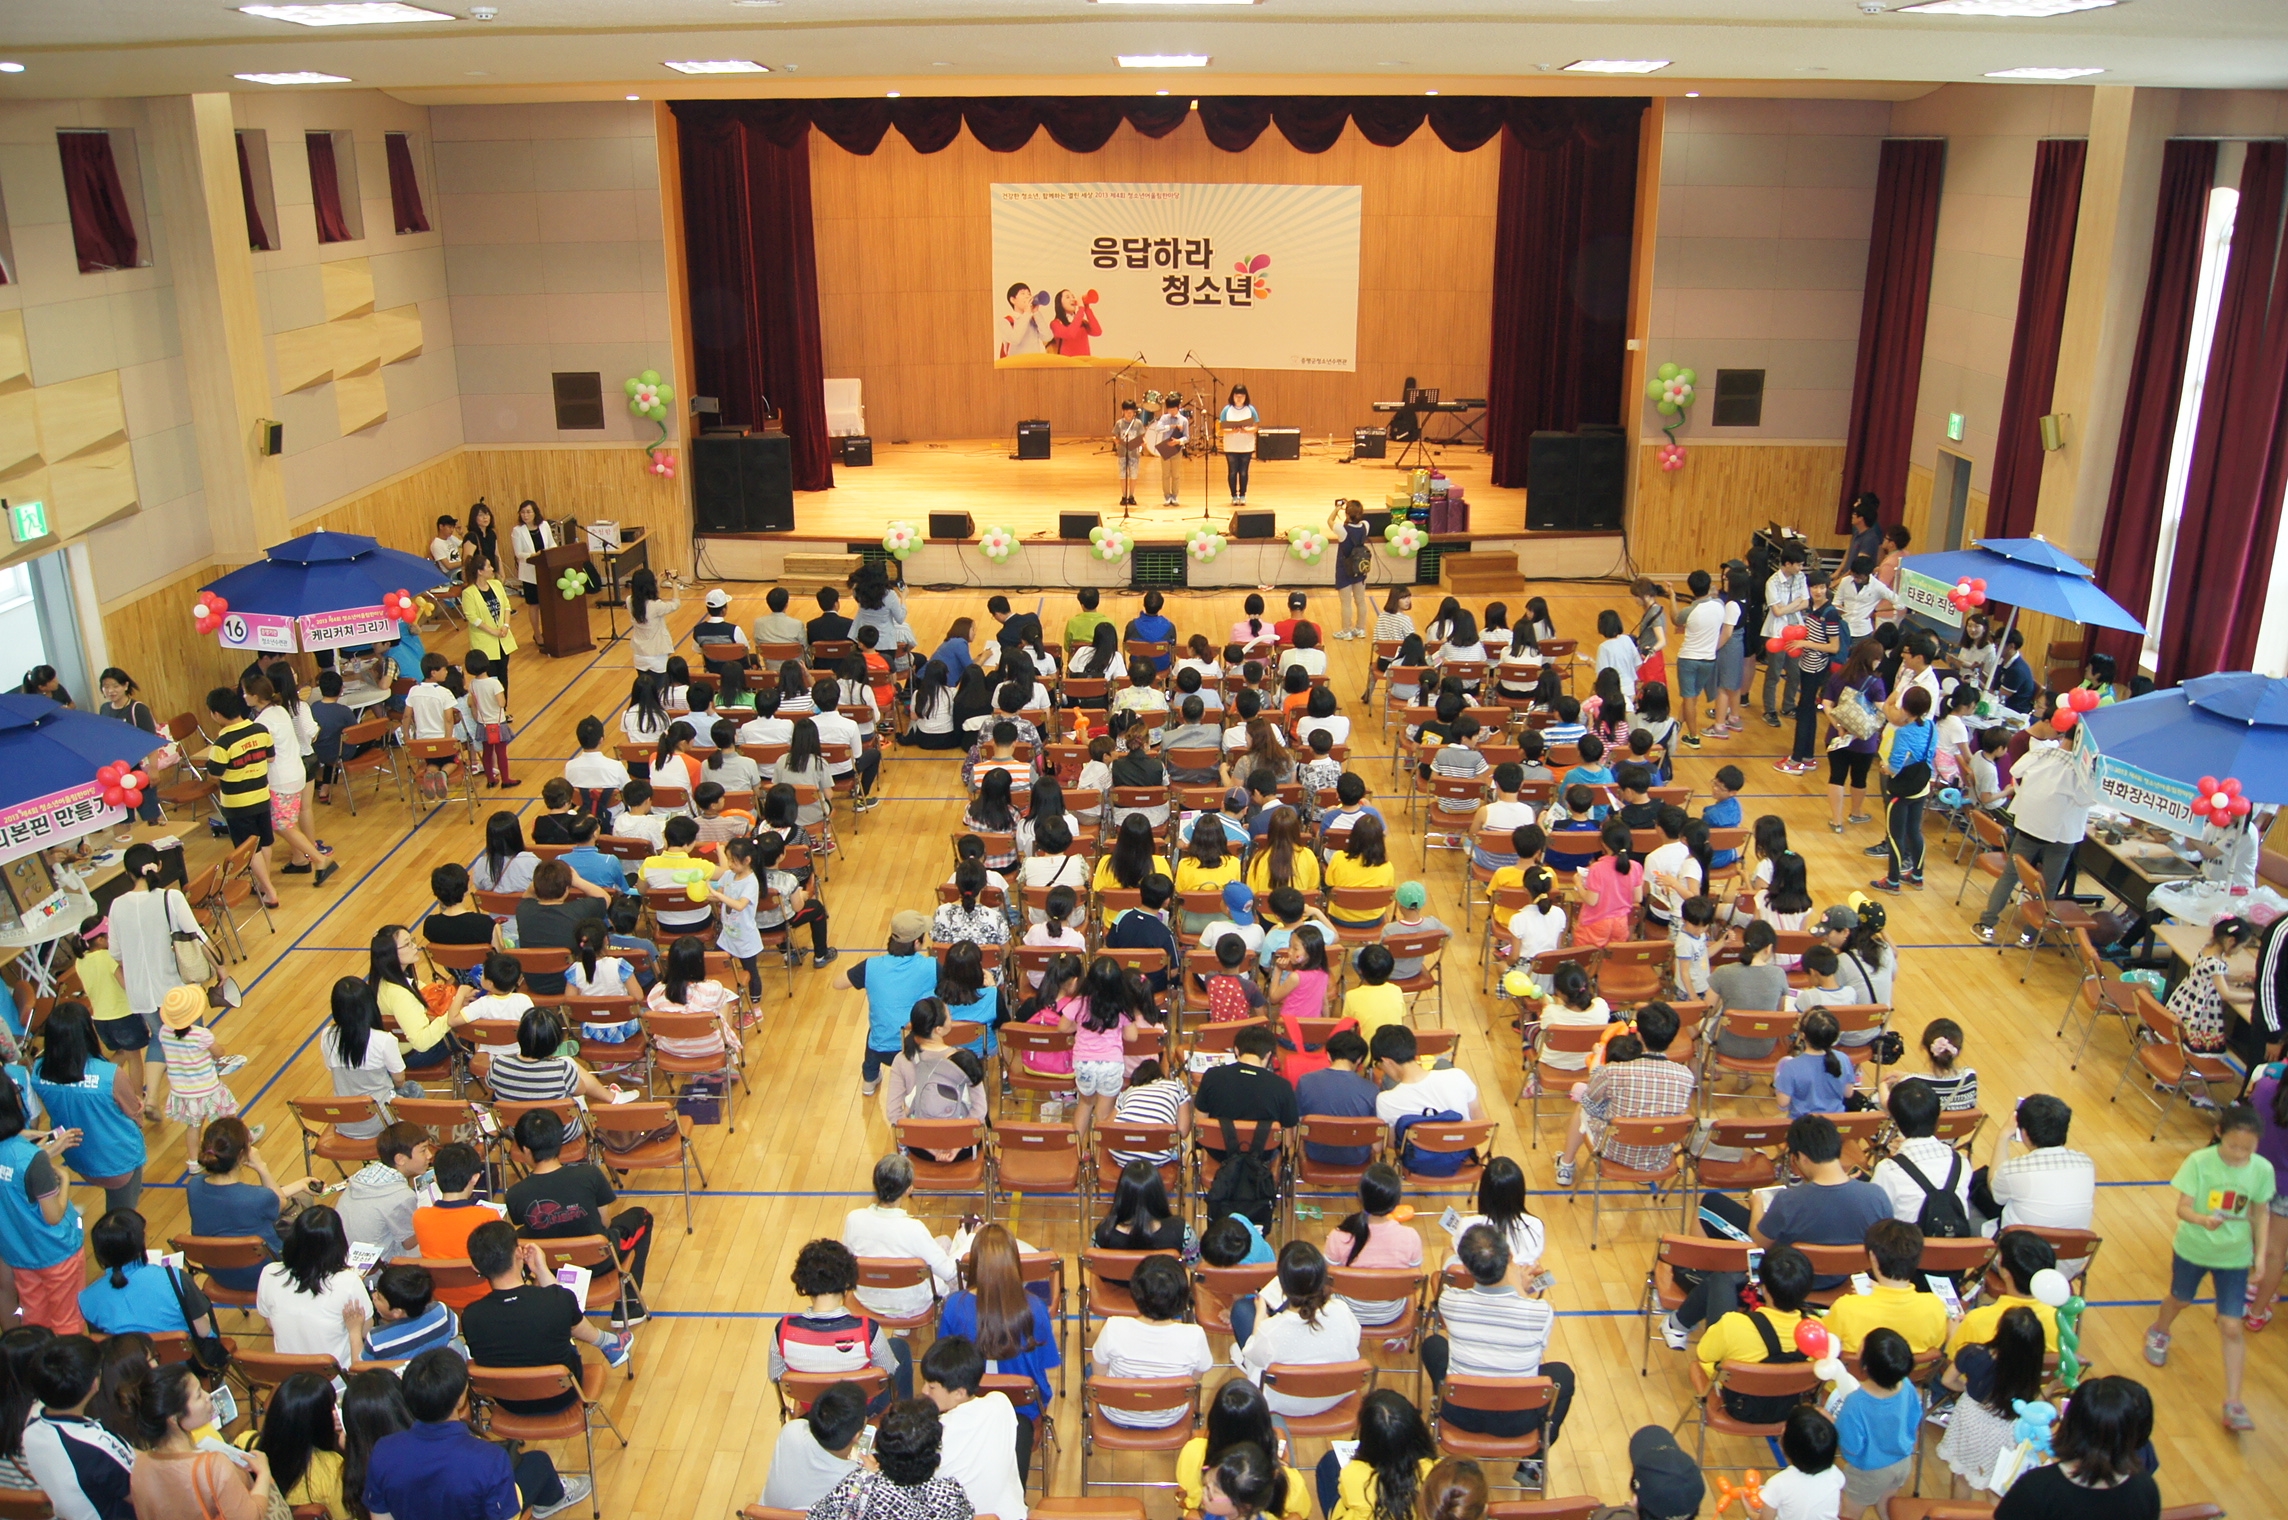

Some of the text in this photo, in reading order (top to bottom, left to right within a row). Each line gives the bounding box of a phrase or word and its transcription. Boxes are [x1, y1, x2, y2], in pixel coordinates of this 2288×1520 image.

[1090, 237, 1214, 270] 응답하라
[1162, 275, 1253, 307] 청소년
[1908, 587, 1956, 615] 타로와 직업
[225, 621, 244, 638] 16
[357, 619, 390, 635] 그리기
[4, 813, 20, 824] 2013
[20, 806, 39, 818] 제4회
[53, 796, 115, 828] 만들기
[2102, 778, 2194, 824] 벽화장식꾸미기
